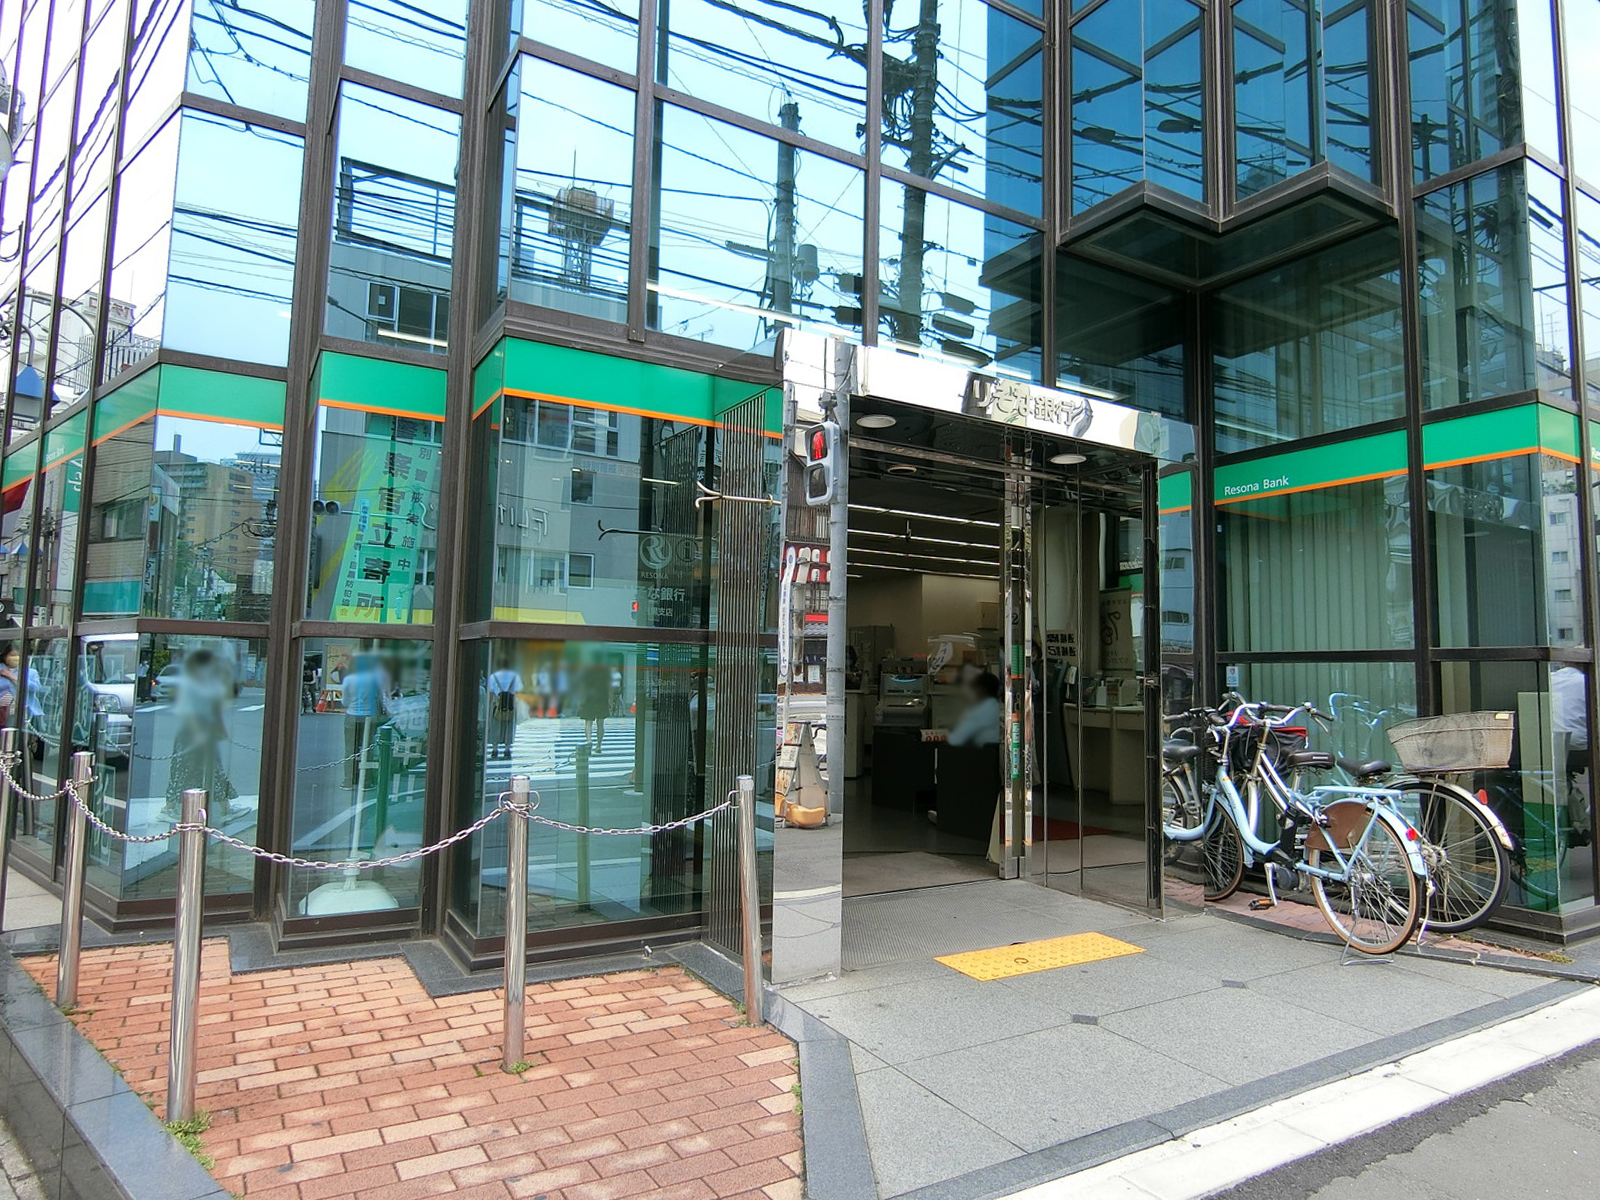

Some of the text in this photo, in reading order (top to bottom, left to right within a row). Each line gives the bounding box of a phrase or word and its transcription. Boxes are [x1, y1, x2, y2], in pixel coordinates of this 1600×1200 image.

[973, 378, 1075, 426] りそな銀行
[1224, 475, 1289, 496] Resona Bank
